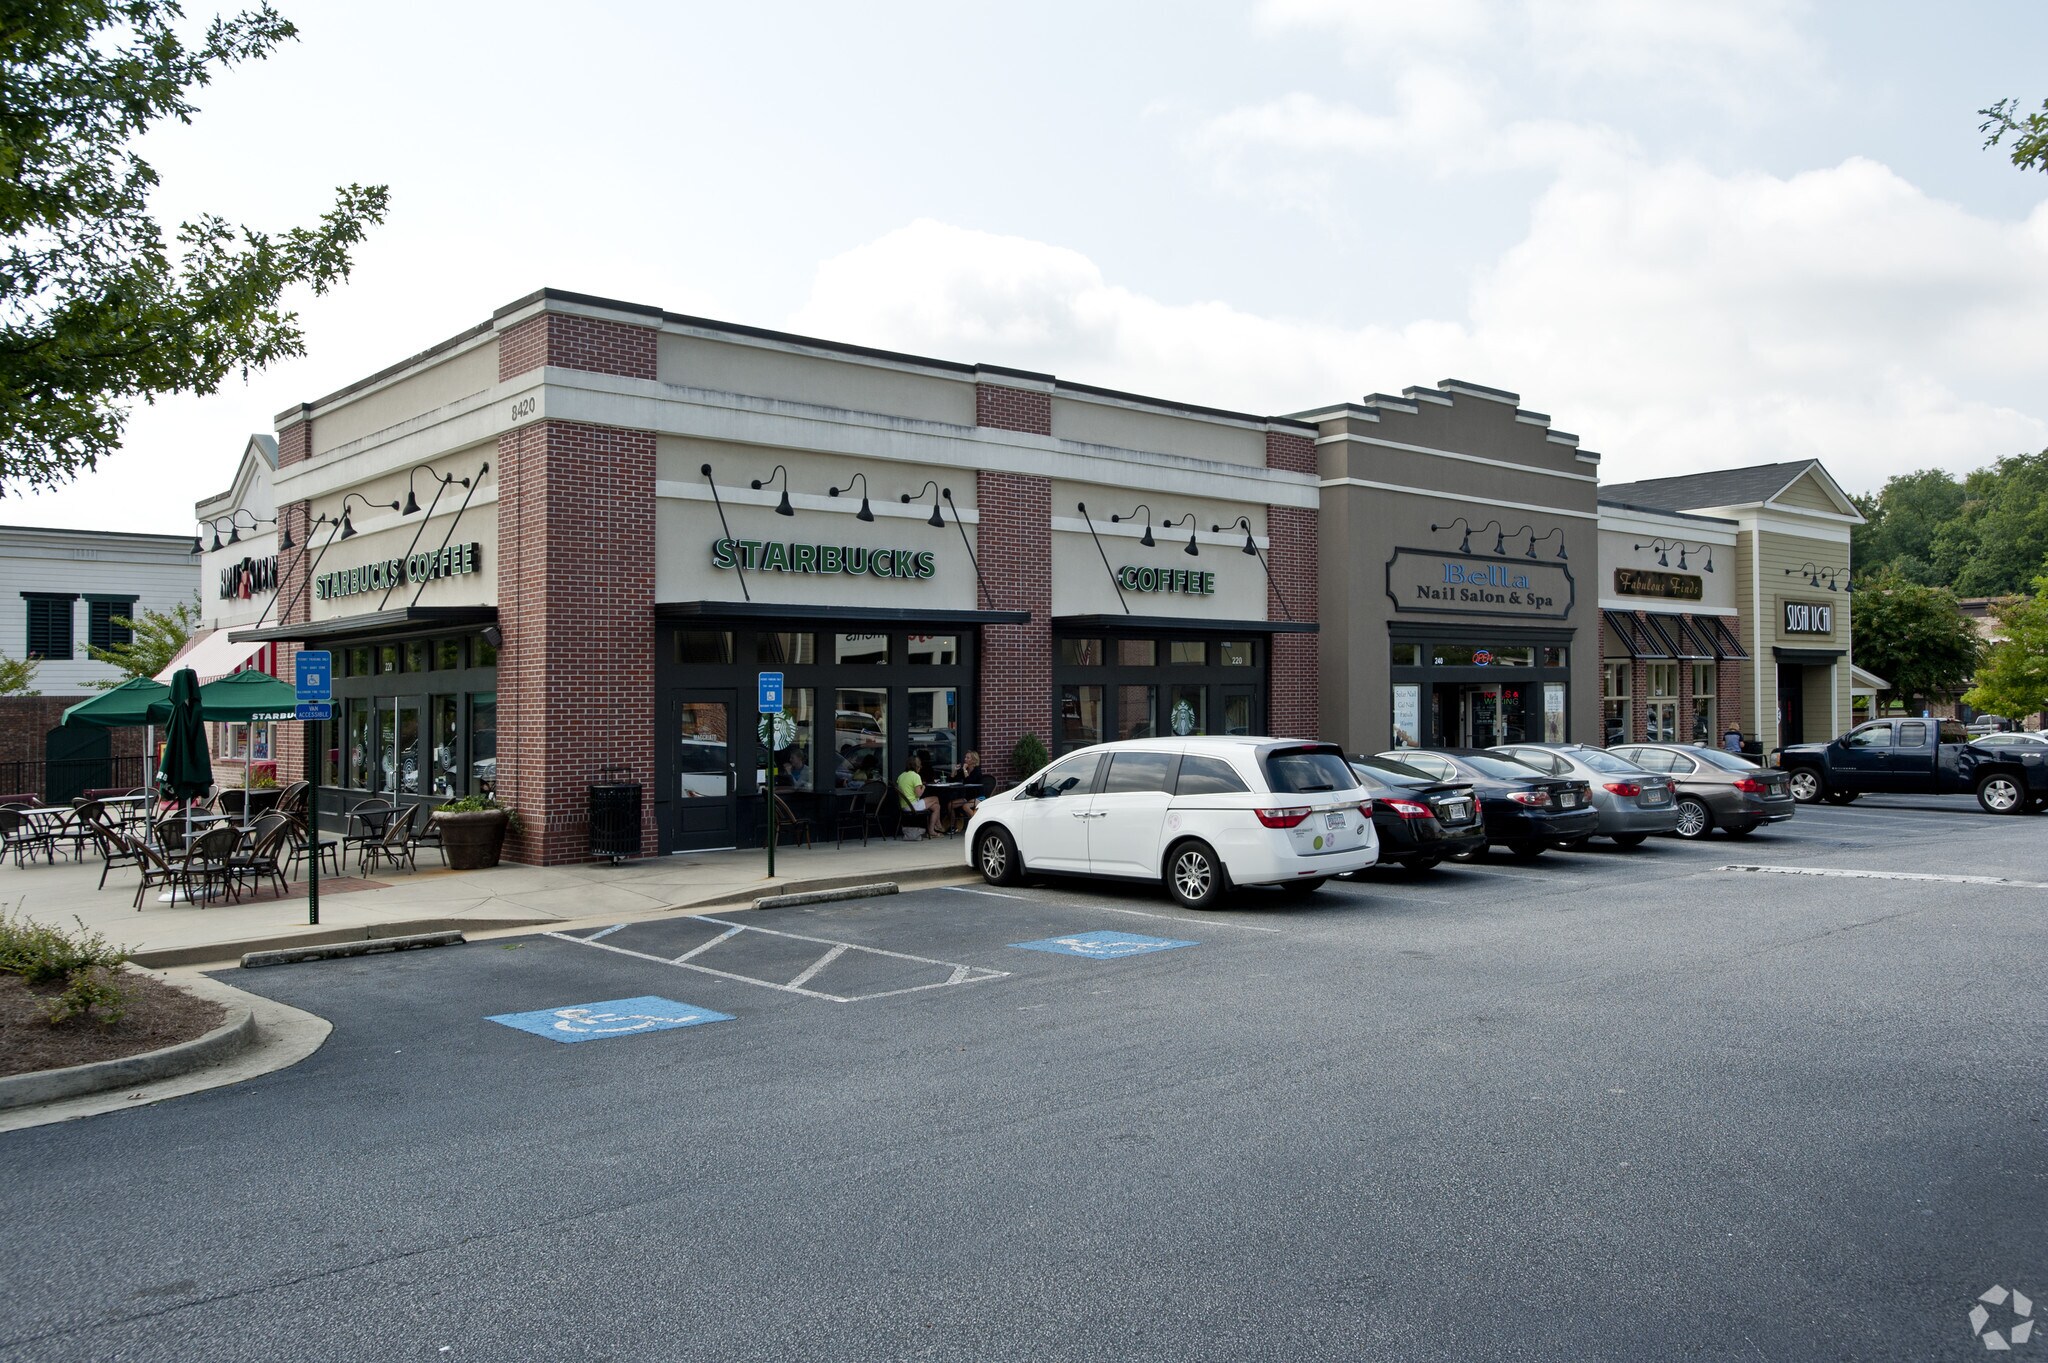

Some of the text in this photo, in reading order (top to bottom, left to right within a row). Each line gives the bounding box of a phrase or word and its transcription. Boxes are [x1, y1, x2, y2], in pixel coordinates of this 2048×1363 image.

[511, 396, 536, 421] 8420
[712, 537, 936, 580] STARBUCKS
[315, 542, 478, 601] STARBUCKS COFFEE
[1117, 565, 1216, 595] COFFEE
[1442, 563, 1530, 589] Bella
[1619, 572, 1699, 595] Fabulous Finds
[1417, 585, 1553, 609] Nail Salon & Spa
[1787, 604, 1831, 632] SUSHI UCHI
[1231, 656, 1243, 665] 220
[1434, 657, 1444, 665] 240
[1472, 653, 1493, 664] OPEN
[1484, 698, 1519, 706] WAING
